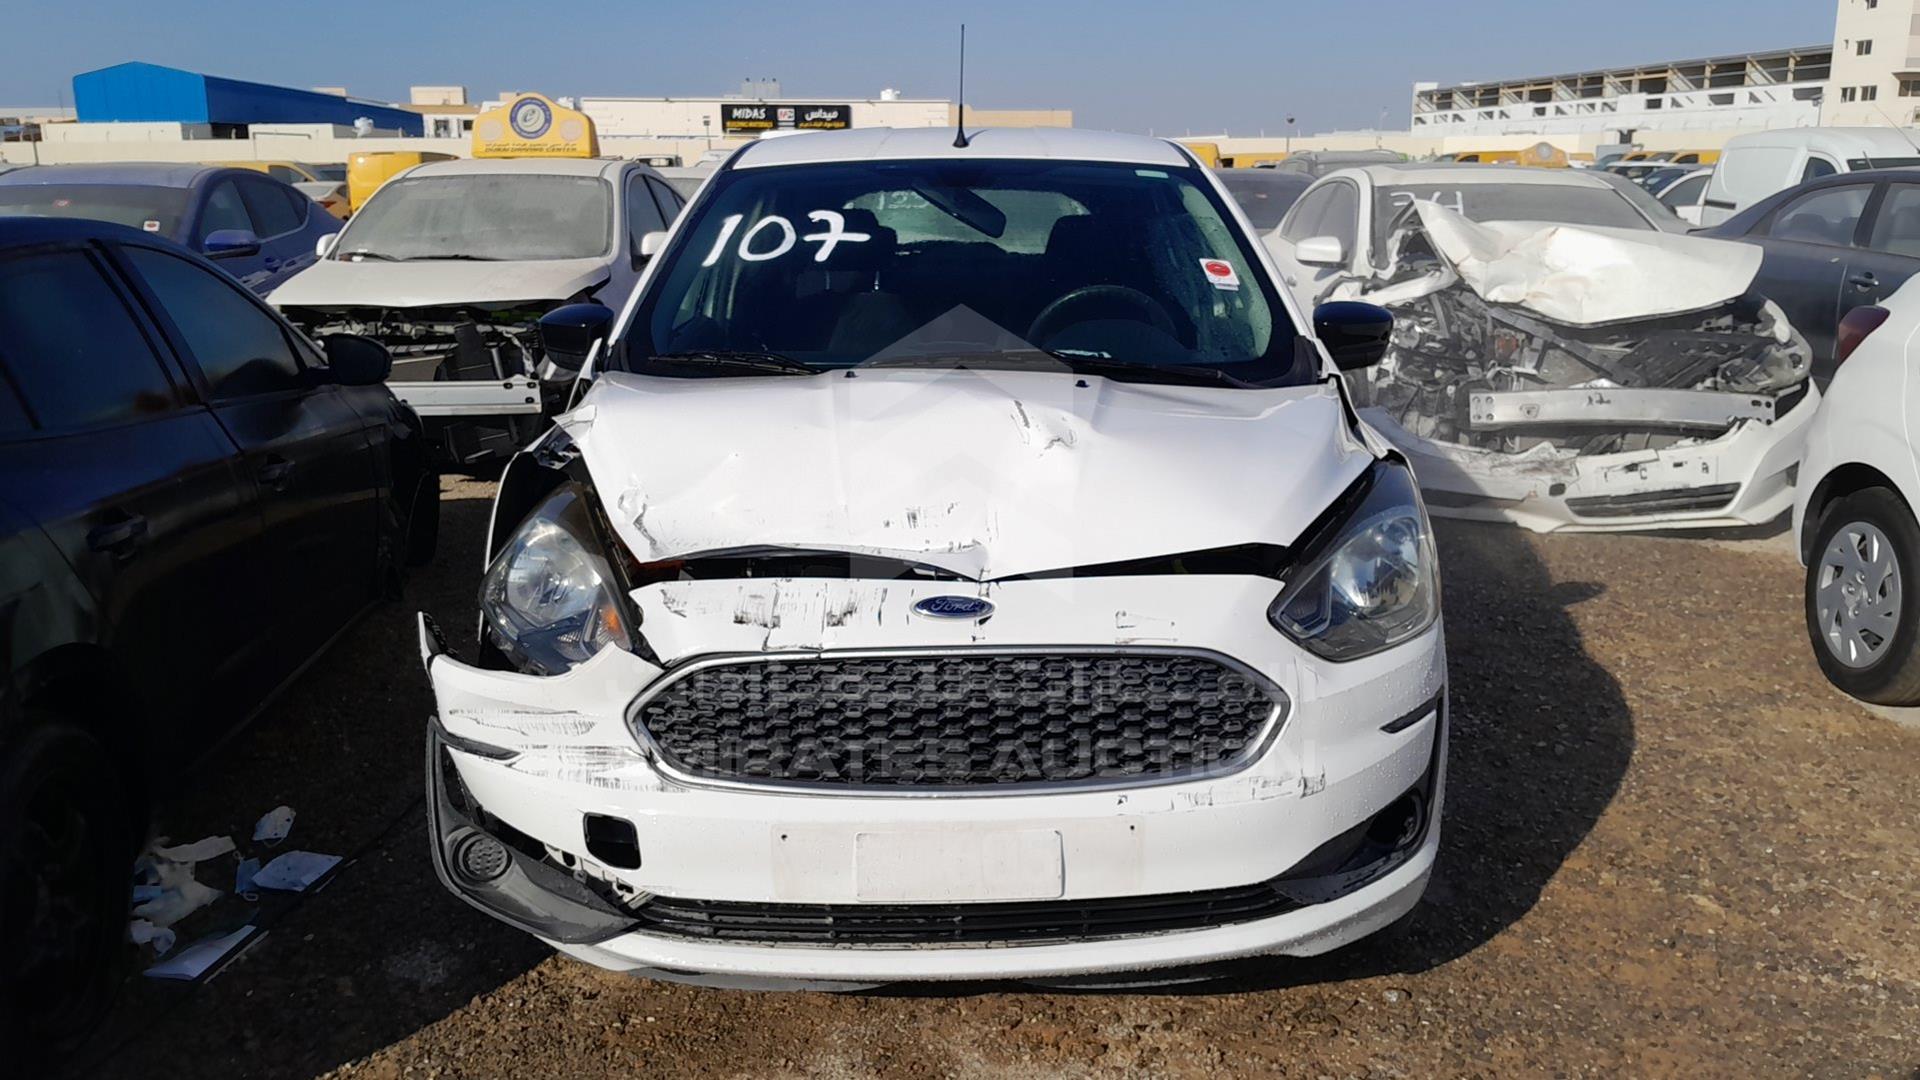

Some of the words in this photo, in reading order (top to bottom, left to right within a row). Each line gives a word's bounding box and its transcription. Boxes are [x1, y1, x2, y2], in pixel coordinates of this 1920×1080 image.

[732, 108, 766, 119] MIDAS
[804, 108, 839, 121] ميداس
[701, 209, 871, 267] 107
[930, 598, 976, 612] Ford
